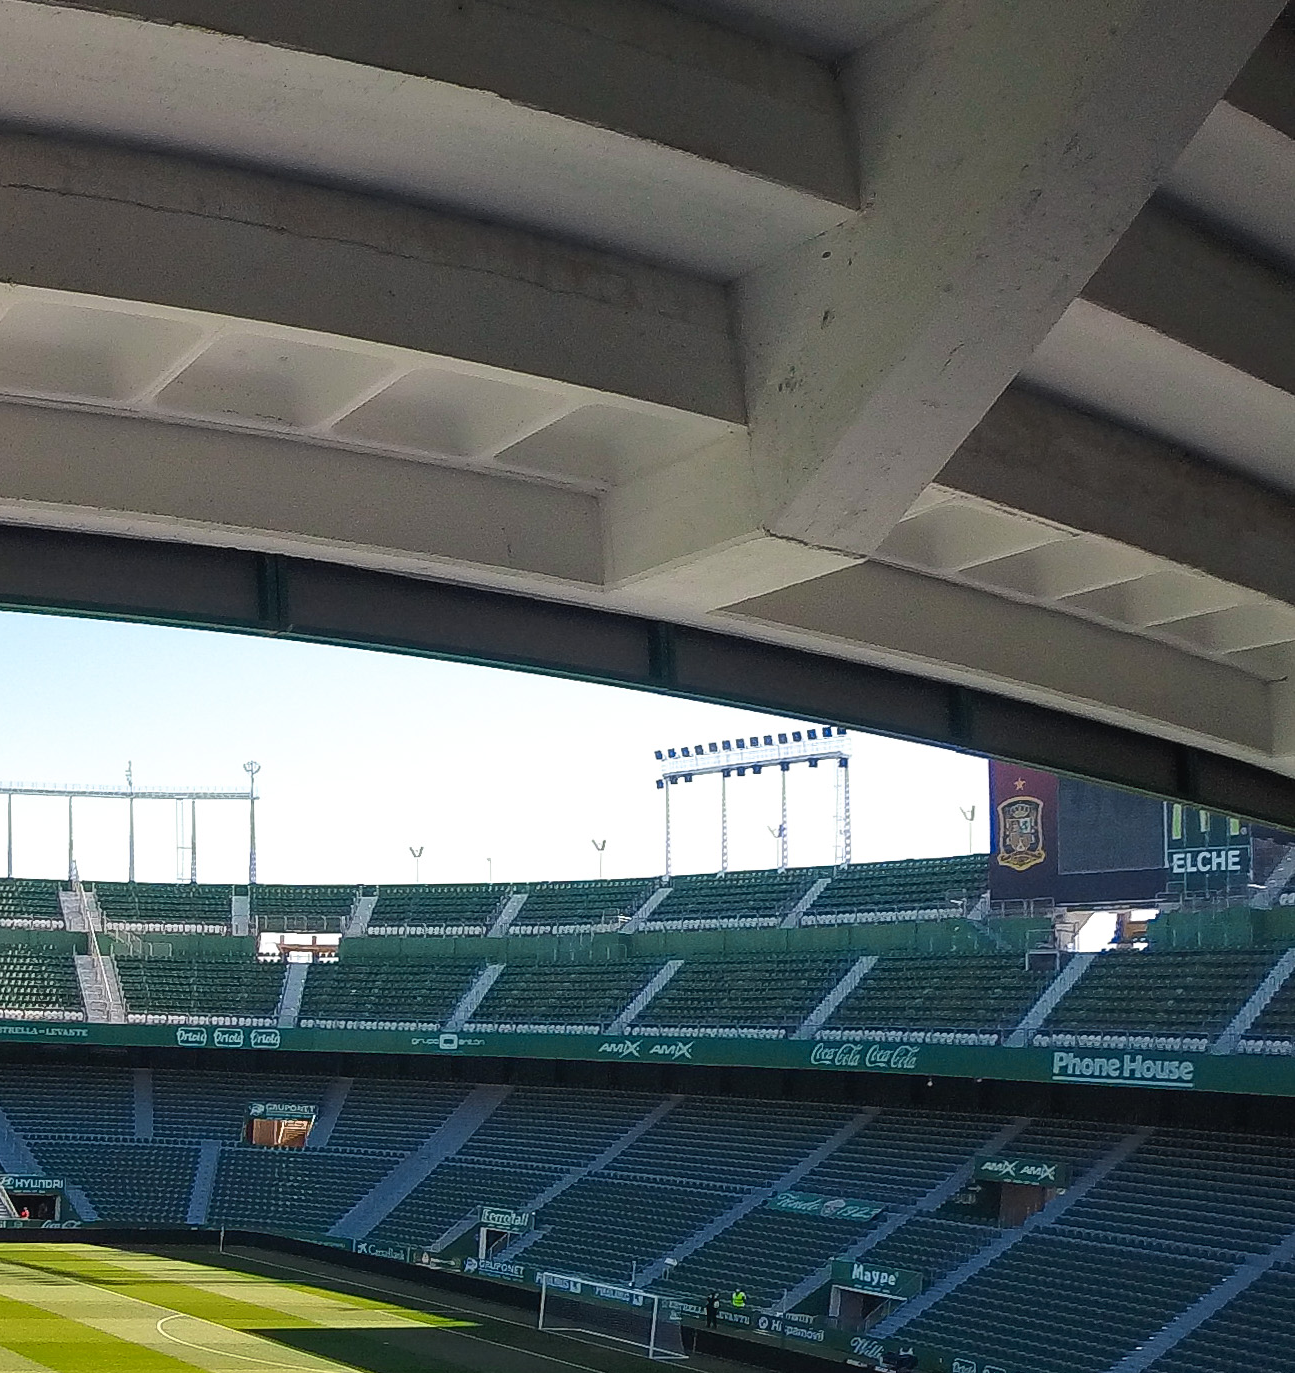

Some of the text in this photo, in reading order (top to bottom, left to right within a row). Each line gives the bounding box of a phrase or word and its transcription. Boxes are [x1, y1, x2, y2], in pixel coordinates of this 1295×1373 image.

[1172, 849, 1241, 874] ELCHE
[45, 1027, 89, 1036] LEVANTE
[598, 1039, 644, 1059] AMIX
[649, 1040, 696, 1060] AMIX
[811, 1042, 863, 1066] Coca-Cola
[865, 1044, 921, 1069] Coca-Cola
[1052, 1051, 1195, 1081] Phone House
[14, 1178, 64, 1189] HYUNDAI
[851, 1263, 899, 1287] Maype
